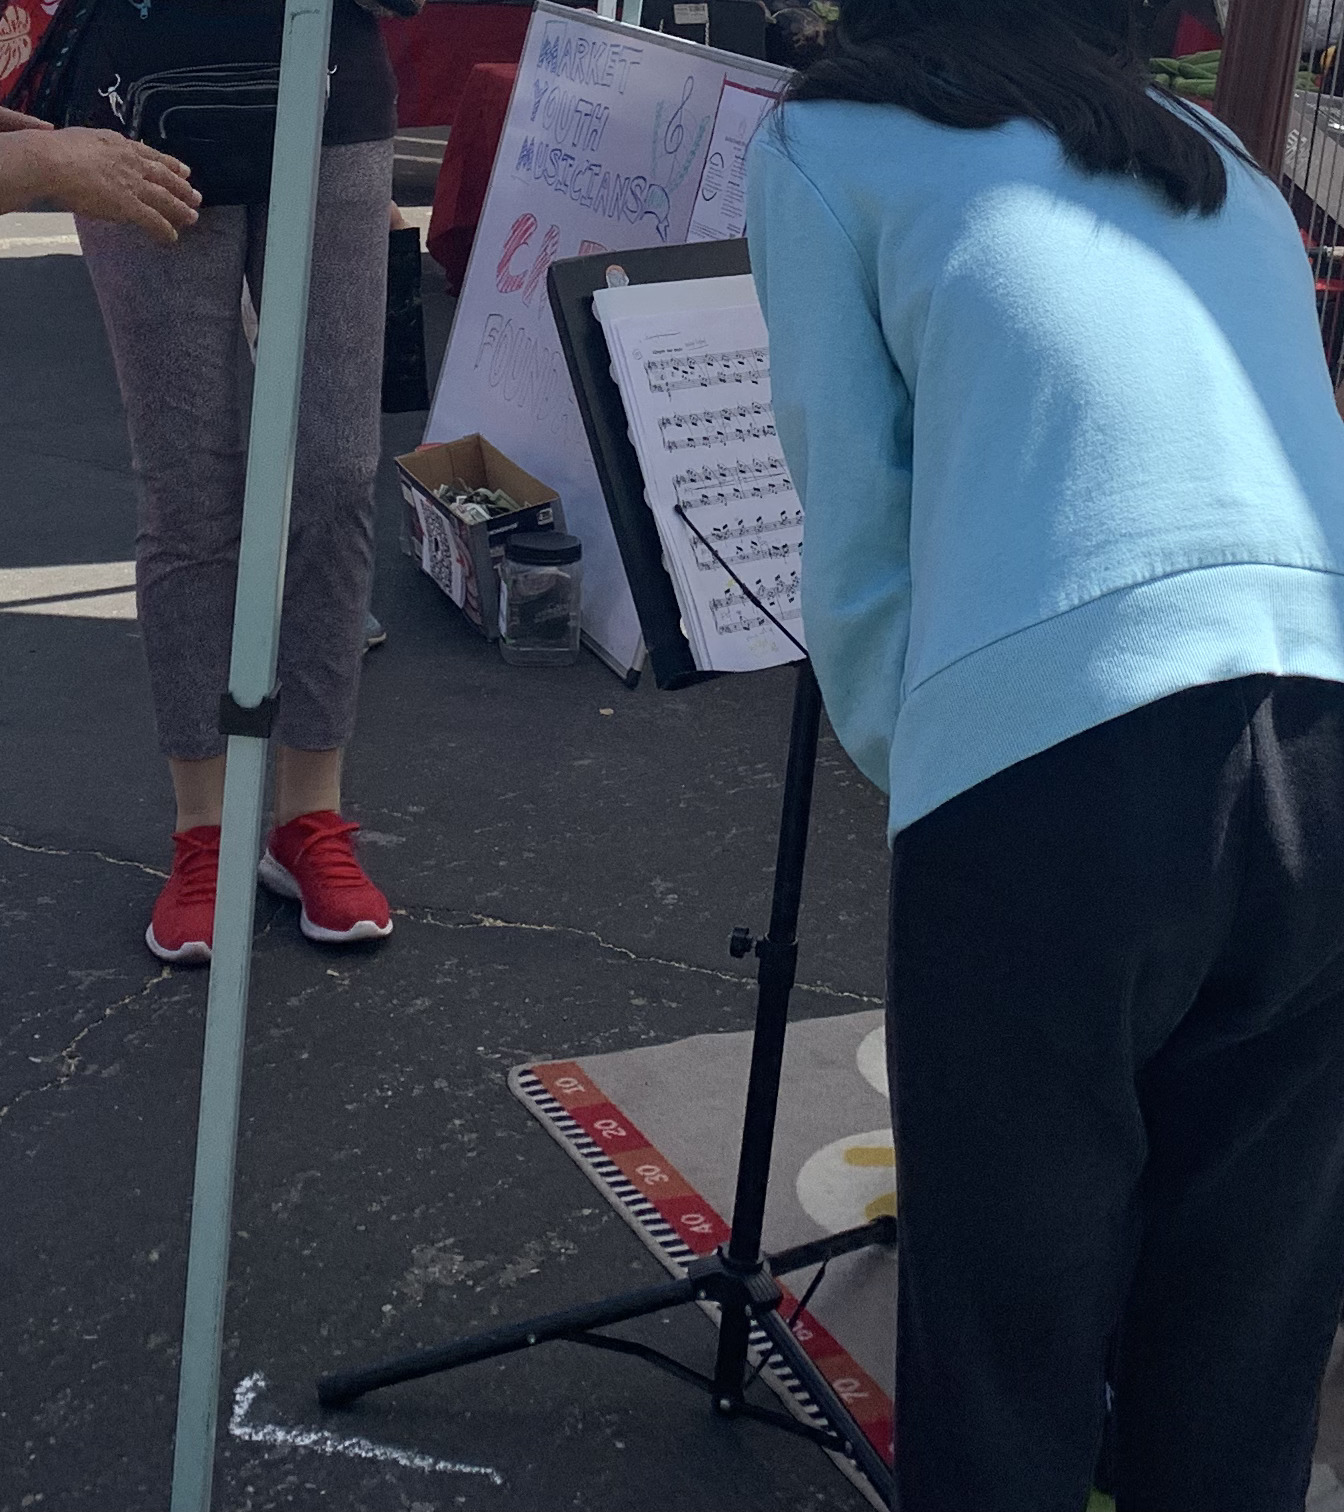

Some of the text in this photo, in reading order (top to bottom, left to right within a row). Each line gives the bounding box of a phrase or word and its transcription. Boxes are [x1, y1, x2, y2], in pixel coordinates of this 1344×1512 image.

[536, 34, 643, 96] MARKET
[530, 79, 610, 152] YOUTH
[515, 135, 648, 225] MUSICIANS
[556, 1076, 586, 1094] 10
[593, 1119, 627, 1139] 20
[635, 1164, 669, 1185] 30
[681, 1213, 713, 1234] 40
